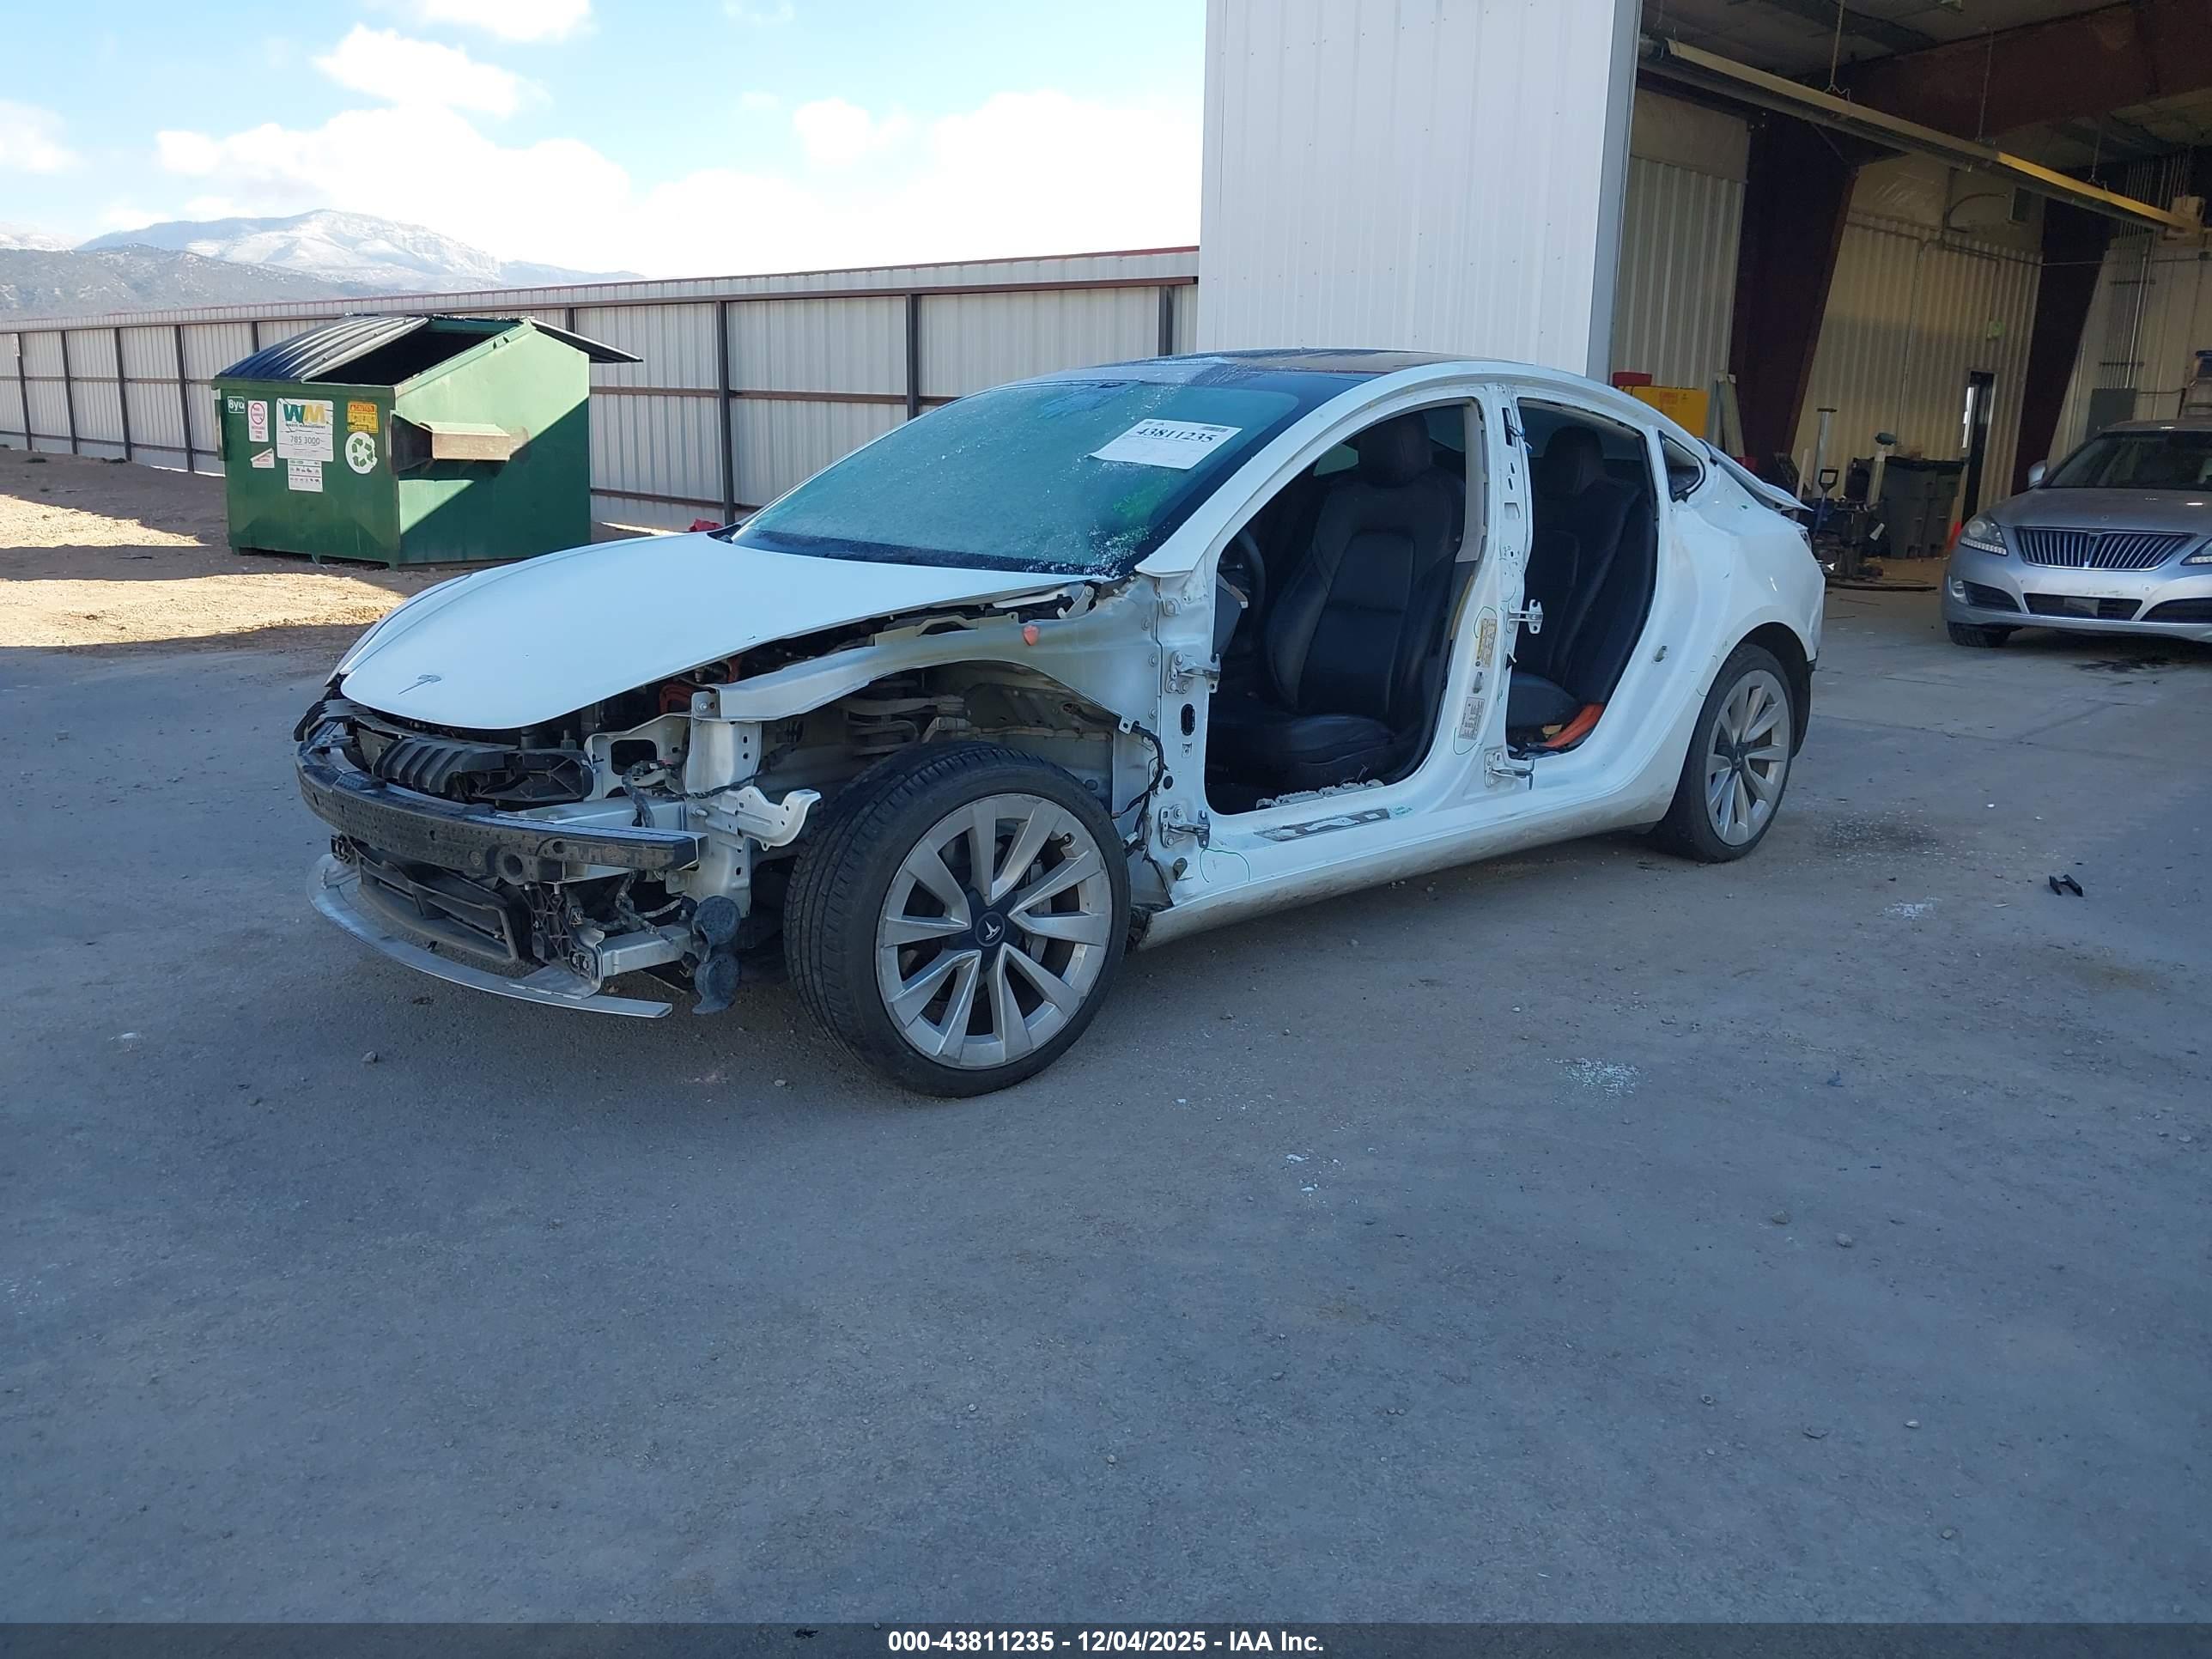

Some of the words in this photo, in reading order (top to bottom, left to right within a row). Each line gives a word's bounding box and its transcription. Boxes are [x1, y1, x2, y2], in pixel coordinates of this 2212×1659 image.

[283, 404, 325, 423] WM
[304, 436, 320, 445] 3000
[1137, 428, 1218, 443] 43811235
